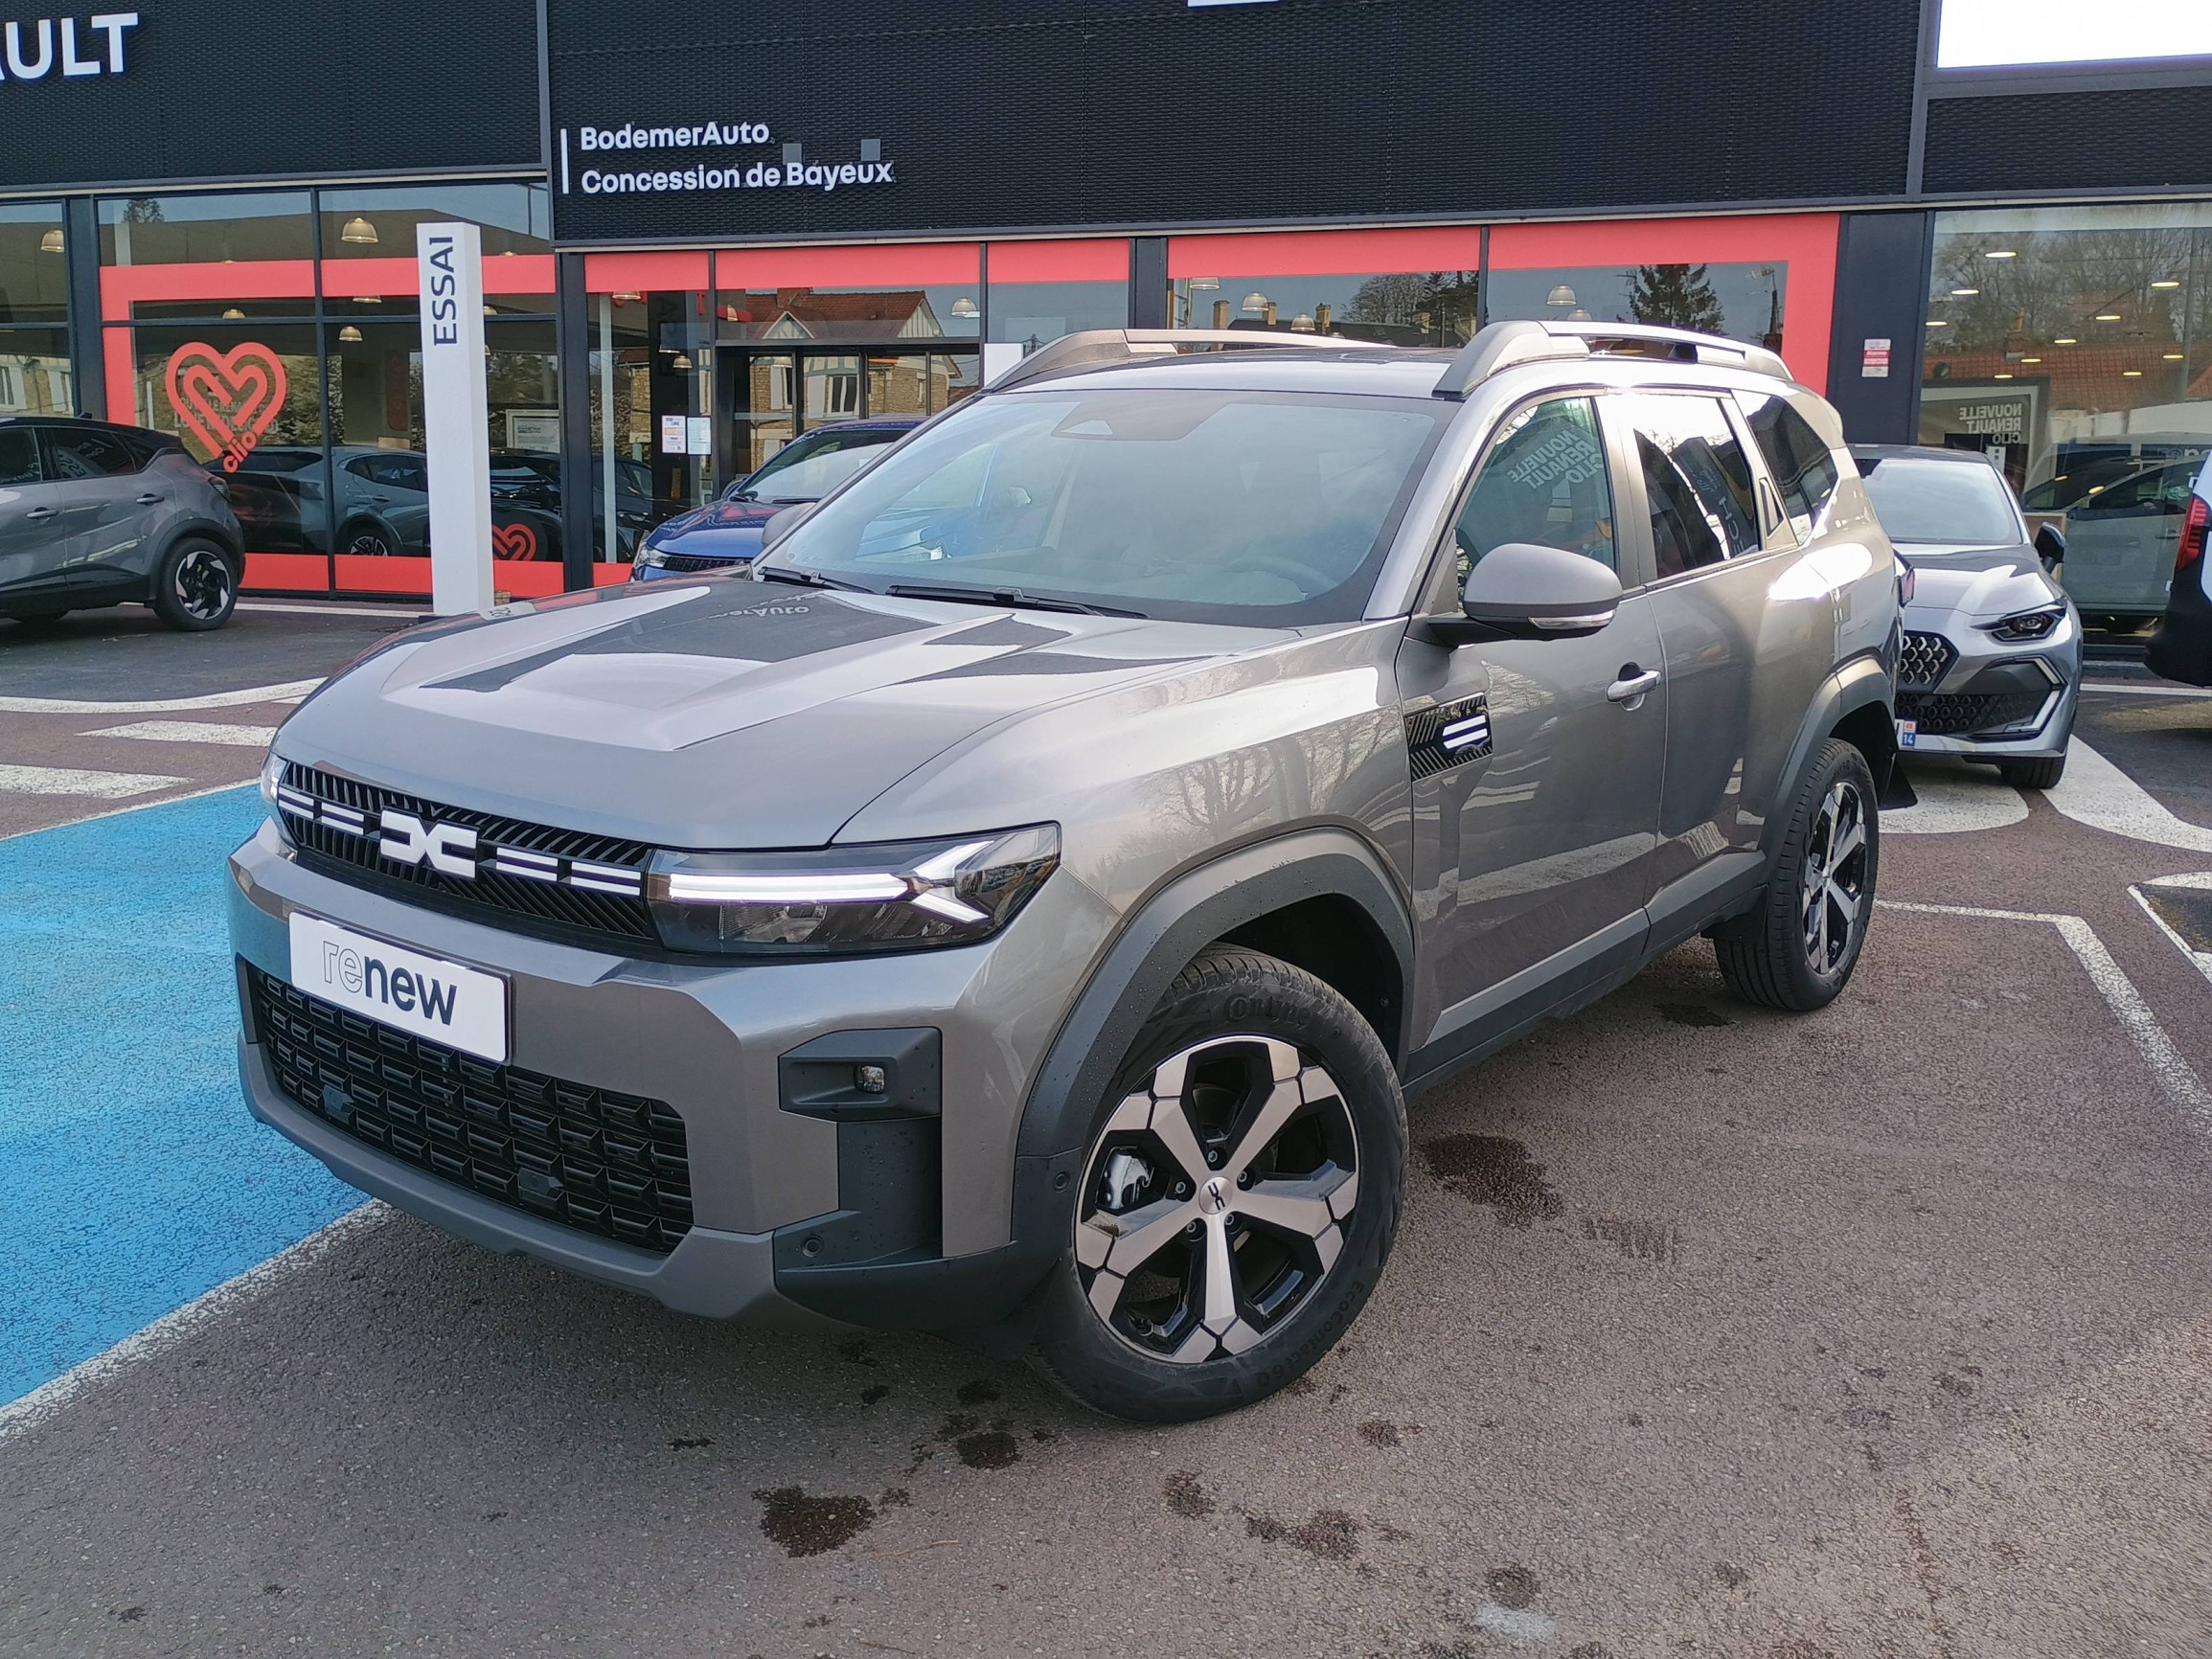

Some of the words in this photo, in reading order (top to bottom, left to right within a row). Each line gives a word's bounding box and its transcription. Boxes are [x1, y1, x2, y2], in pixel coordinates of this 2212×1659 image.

[0, 12, 139, 80] ULT
[581, 122, 769, 150] BodemerAuto
[582, 164, 740, 193] Concession
[745, 162, 781, 187] de
[787, 161, 894, 191] Bayeux
[428, 237, 457, 346] ESSAI
[223, 431, 257, 473] clio
[323, 940, 458, 1026] renew
